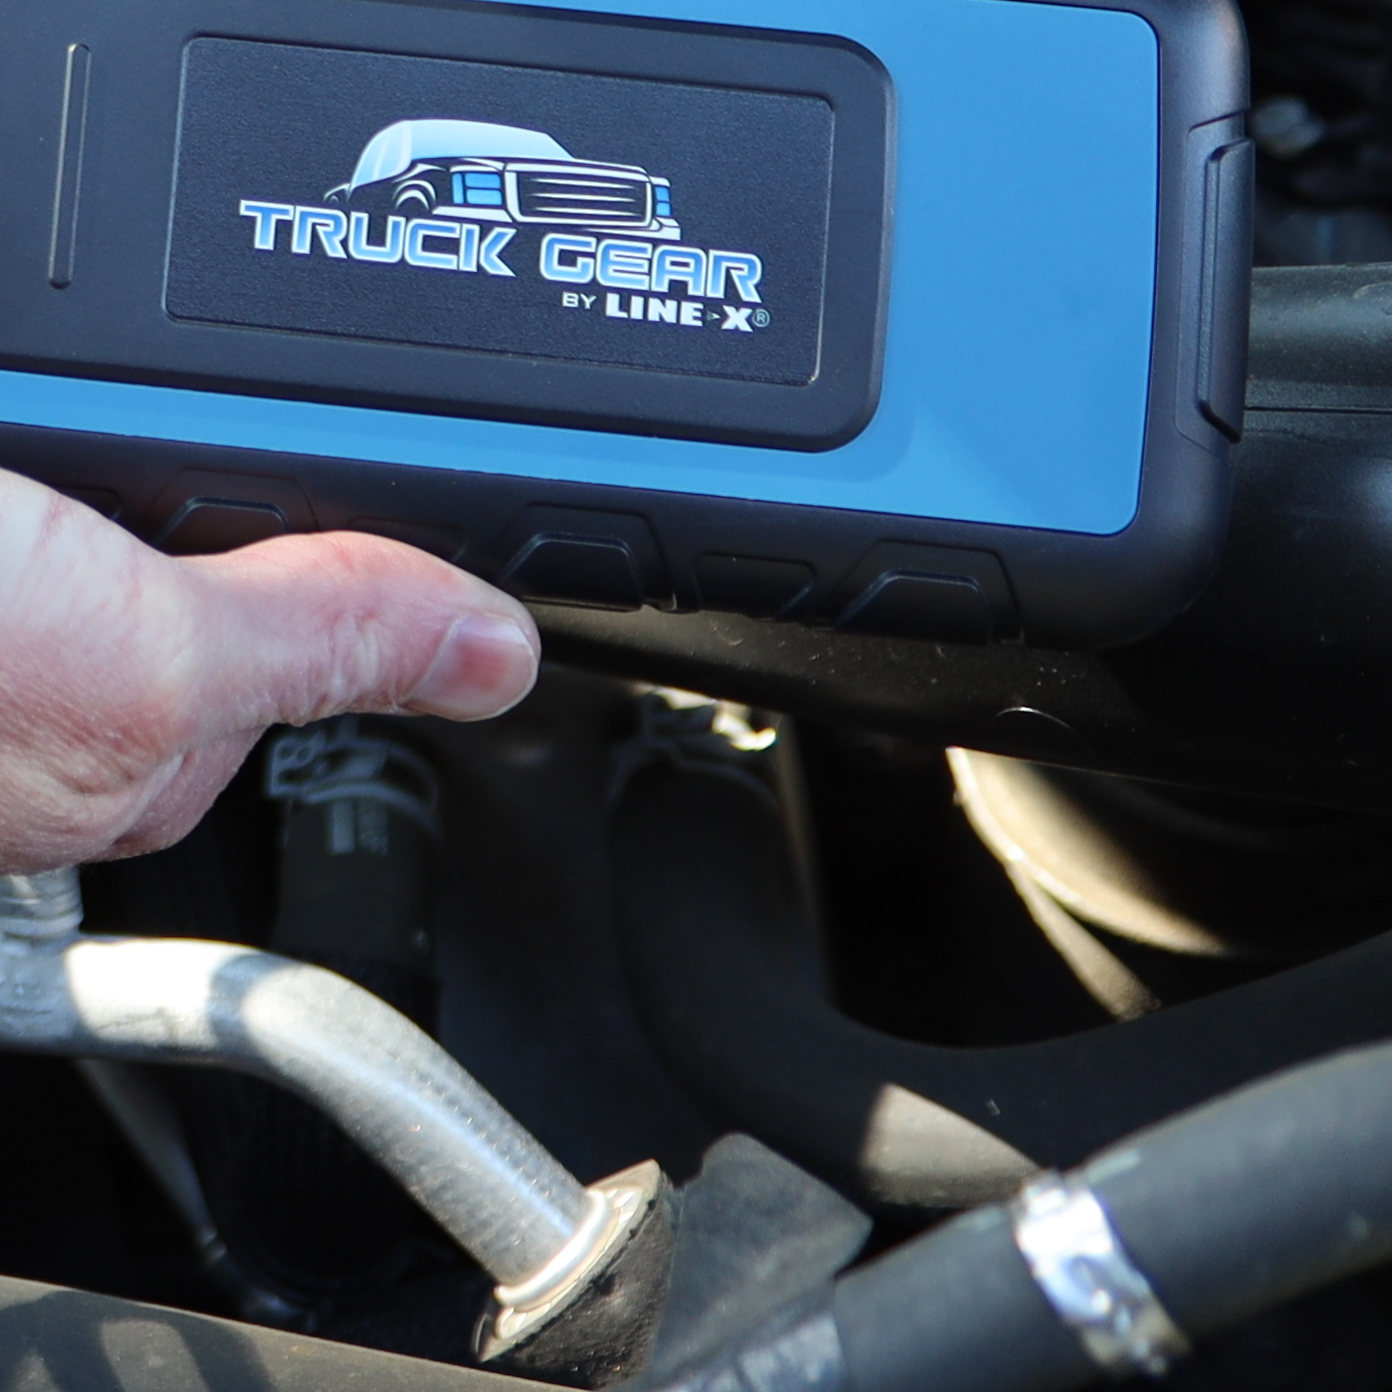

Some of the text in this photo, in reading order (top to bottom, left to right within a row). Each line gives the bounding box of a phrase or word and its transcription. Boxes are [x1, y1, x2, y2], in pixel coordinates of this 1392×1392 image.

[239, 199, 762, 303] TRUCK GEAR
[562, 292, 597, 310] BY
